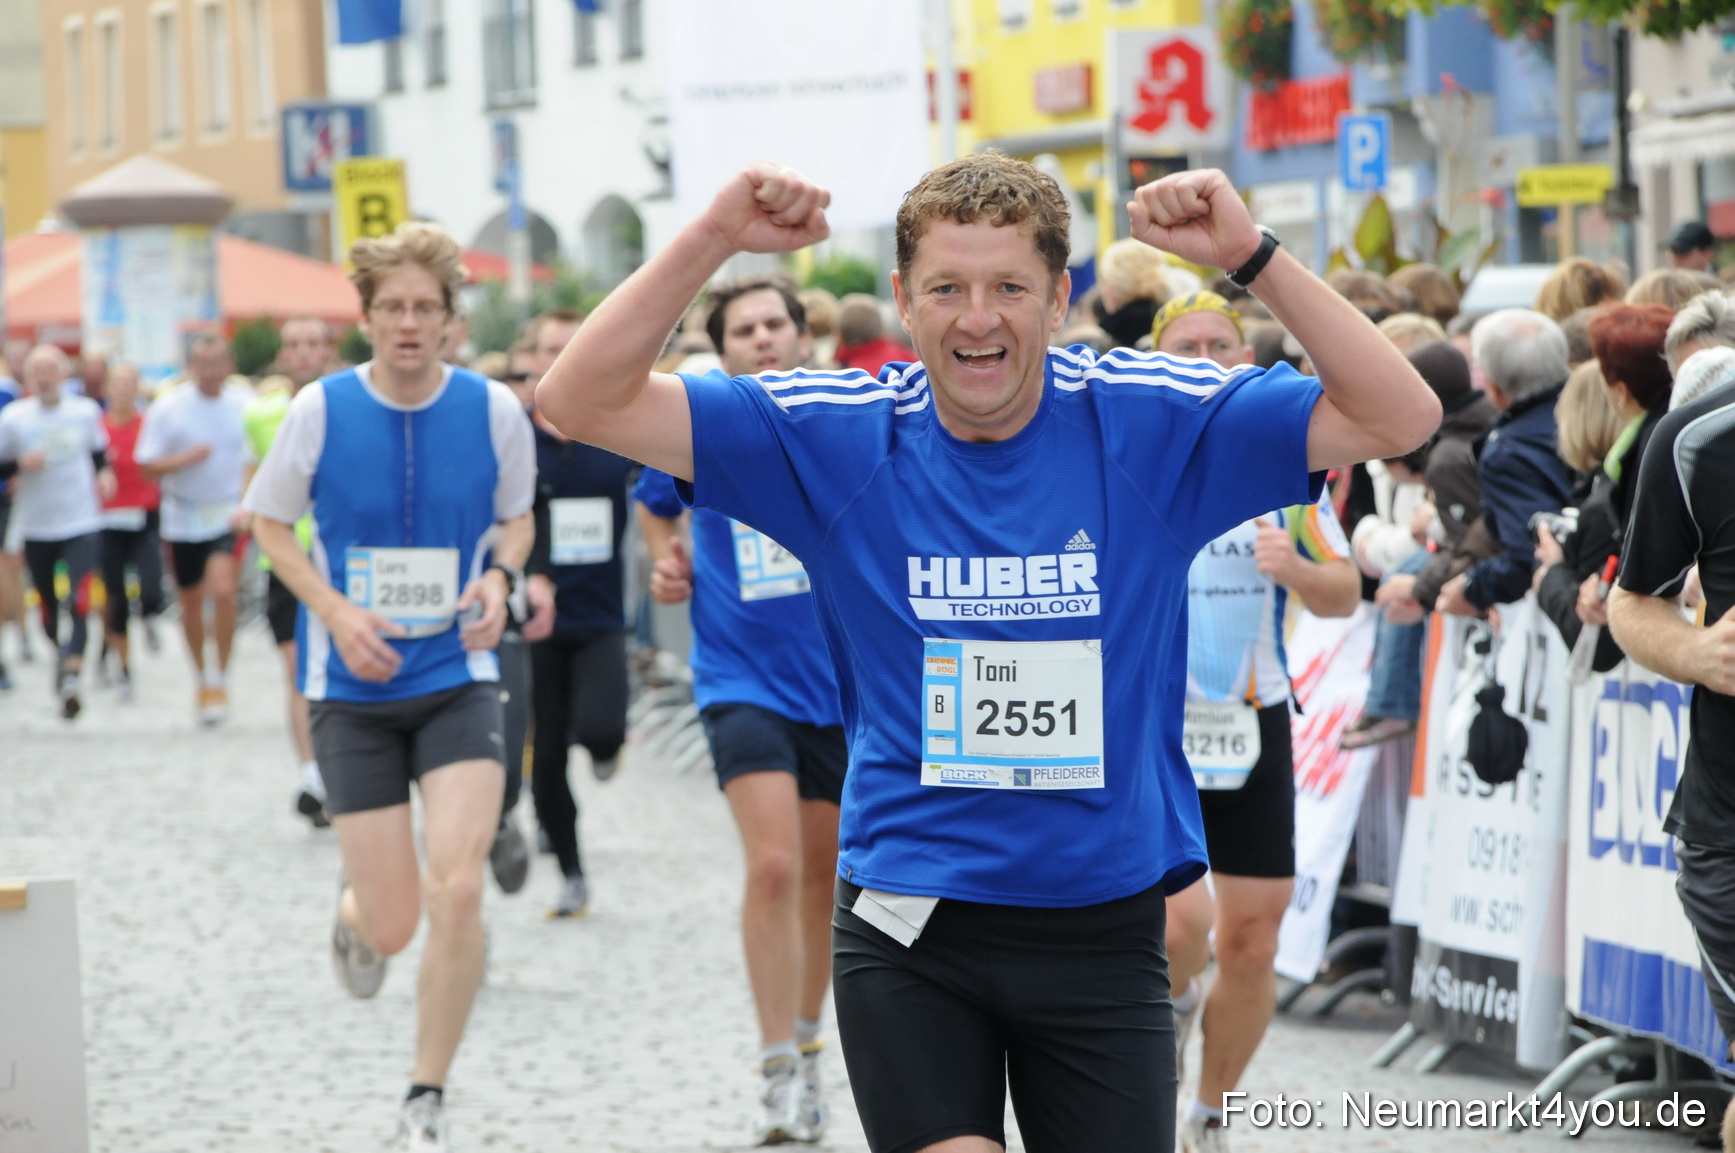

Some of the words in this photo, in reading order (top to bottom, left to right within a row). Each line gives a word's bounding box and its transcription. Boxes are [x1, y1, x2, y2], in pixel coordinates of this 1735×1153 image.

[1348, 121, 1380, 186] P
[357, 193, 394, 238] B
[1064, 541, 1097, 551] adidas
[907, 552, 1100, 597] HUBER
[379, 583, 445, 607] 2898
[948, 598, 1093, 617] TECHNOLOGY
[973, 655, 1017, 682] Toni
[934, 694, 945, 714] B
[975, 698, 1078, 738] 2551
[1183, 732, 1247, 756] 3216
[941, 768, 987, 781] BOCK
[1033, 766, 1101, 780] PFLEIDERER
[1033, 779, 1101, 789] AKTIENGESELLSCHAFT
